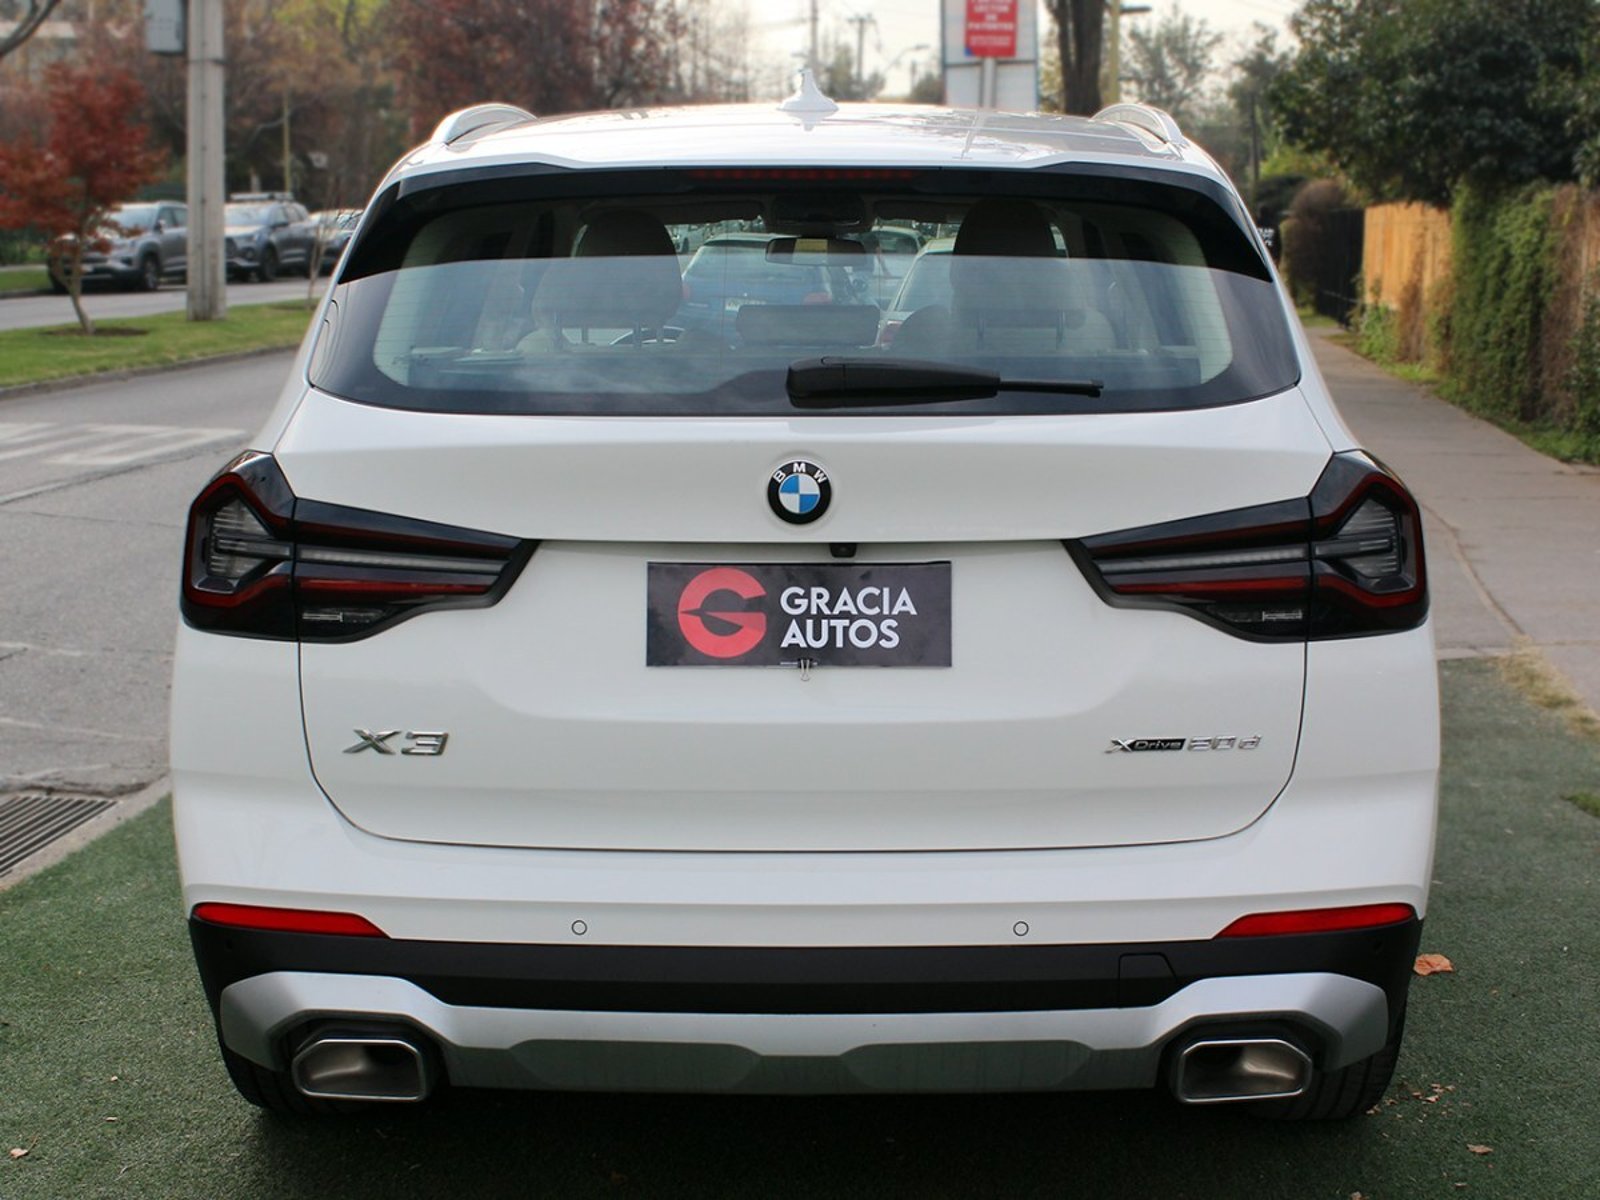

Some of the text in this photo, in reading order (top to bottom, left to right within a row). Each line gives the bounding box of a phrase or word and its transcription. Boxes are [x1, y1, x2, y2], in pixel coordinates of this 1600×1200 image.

[773, 462, 827, 483] BMW
[780, 587, 917, 615] GRACIA
[780, 619, 900, 648] AUTOS
[342, 729, 449, 755] X3
